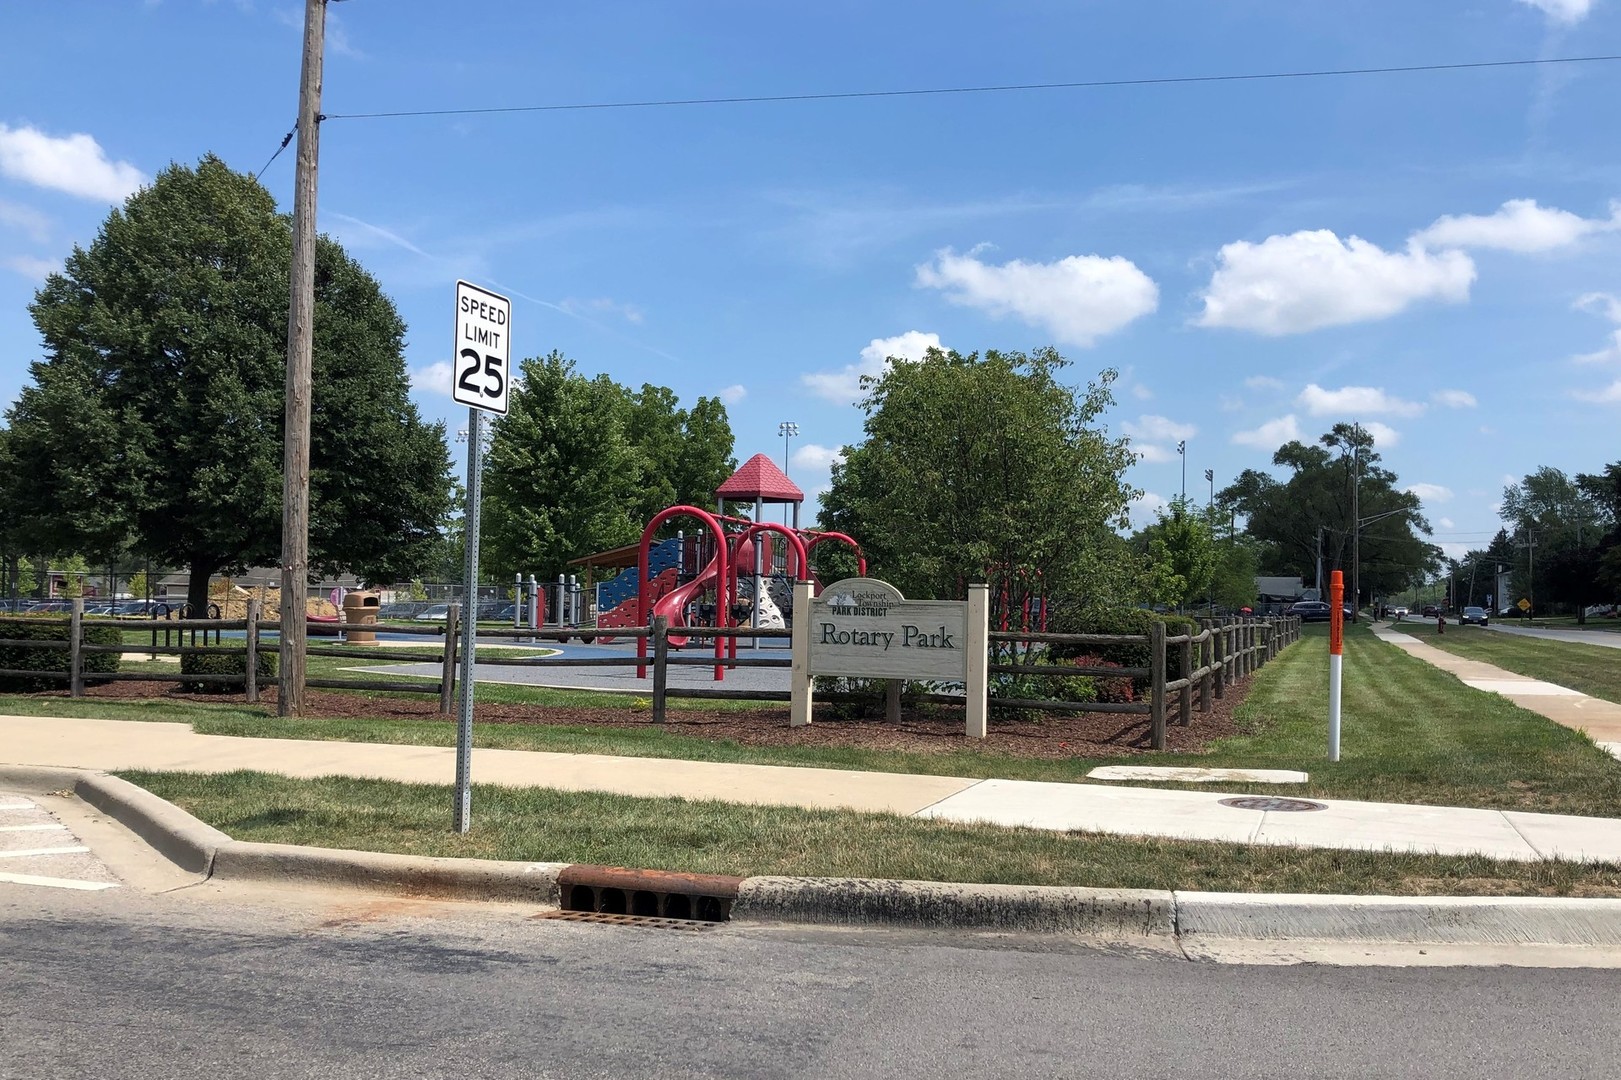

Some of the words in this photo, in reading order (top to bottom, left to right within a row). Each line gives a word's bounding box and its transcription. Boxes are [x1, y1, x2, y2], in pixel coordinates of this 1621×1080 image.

[461, 296, 506, 325] SPEED
[465, 323, 500, 349] LIMIT
[459, 348, 503, 398] 25
[852, 590, 886, 601] Lockport
[858, 598, 894, 609] Township
[832, 607, 851, 616] PARK
[853, 607, 888, 617] DISTRICT
[820, 623, 894, 651] Rotary
[901, 625, 955, 649] Park
